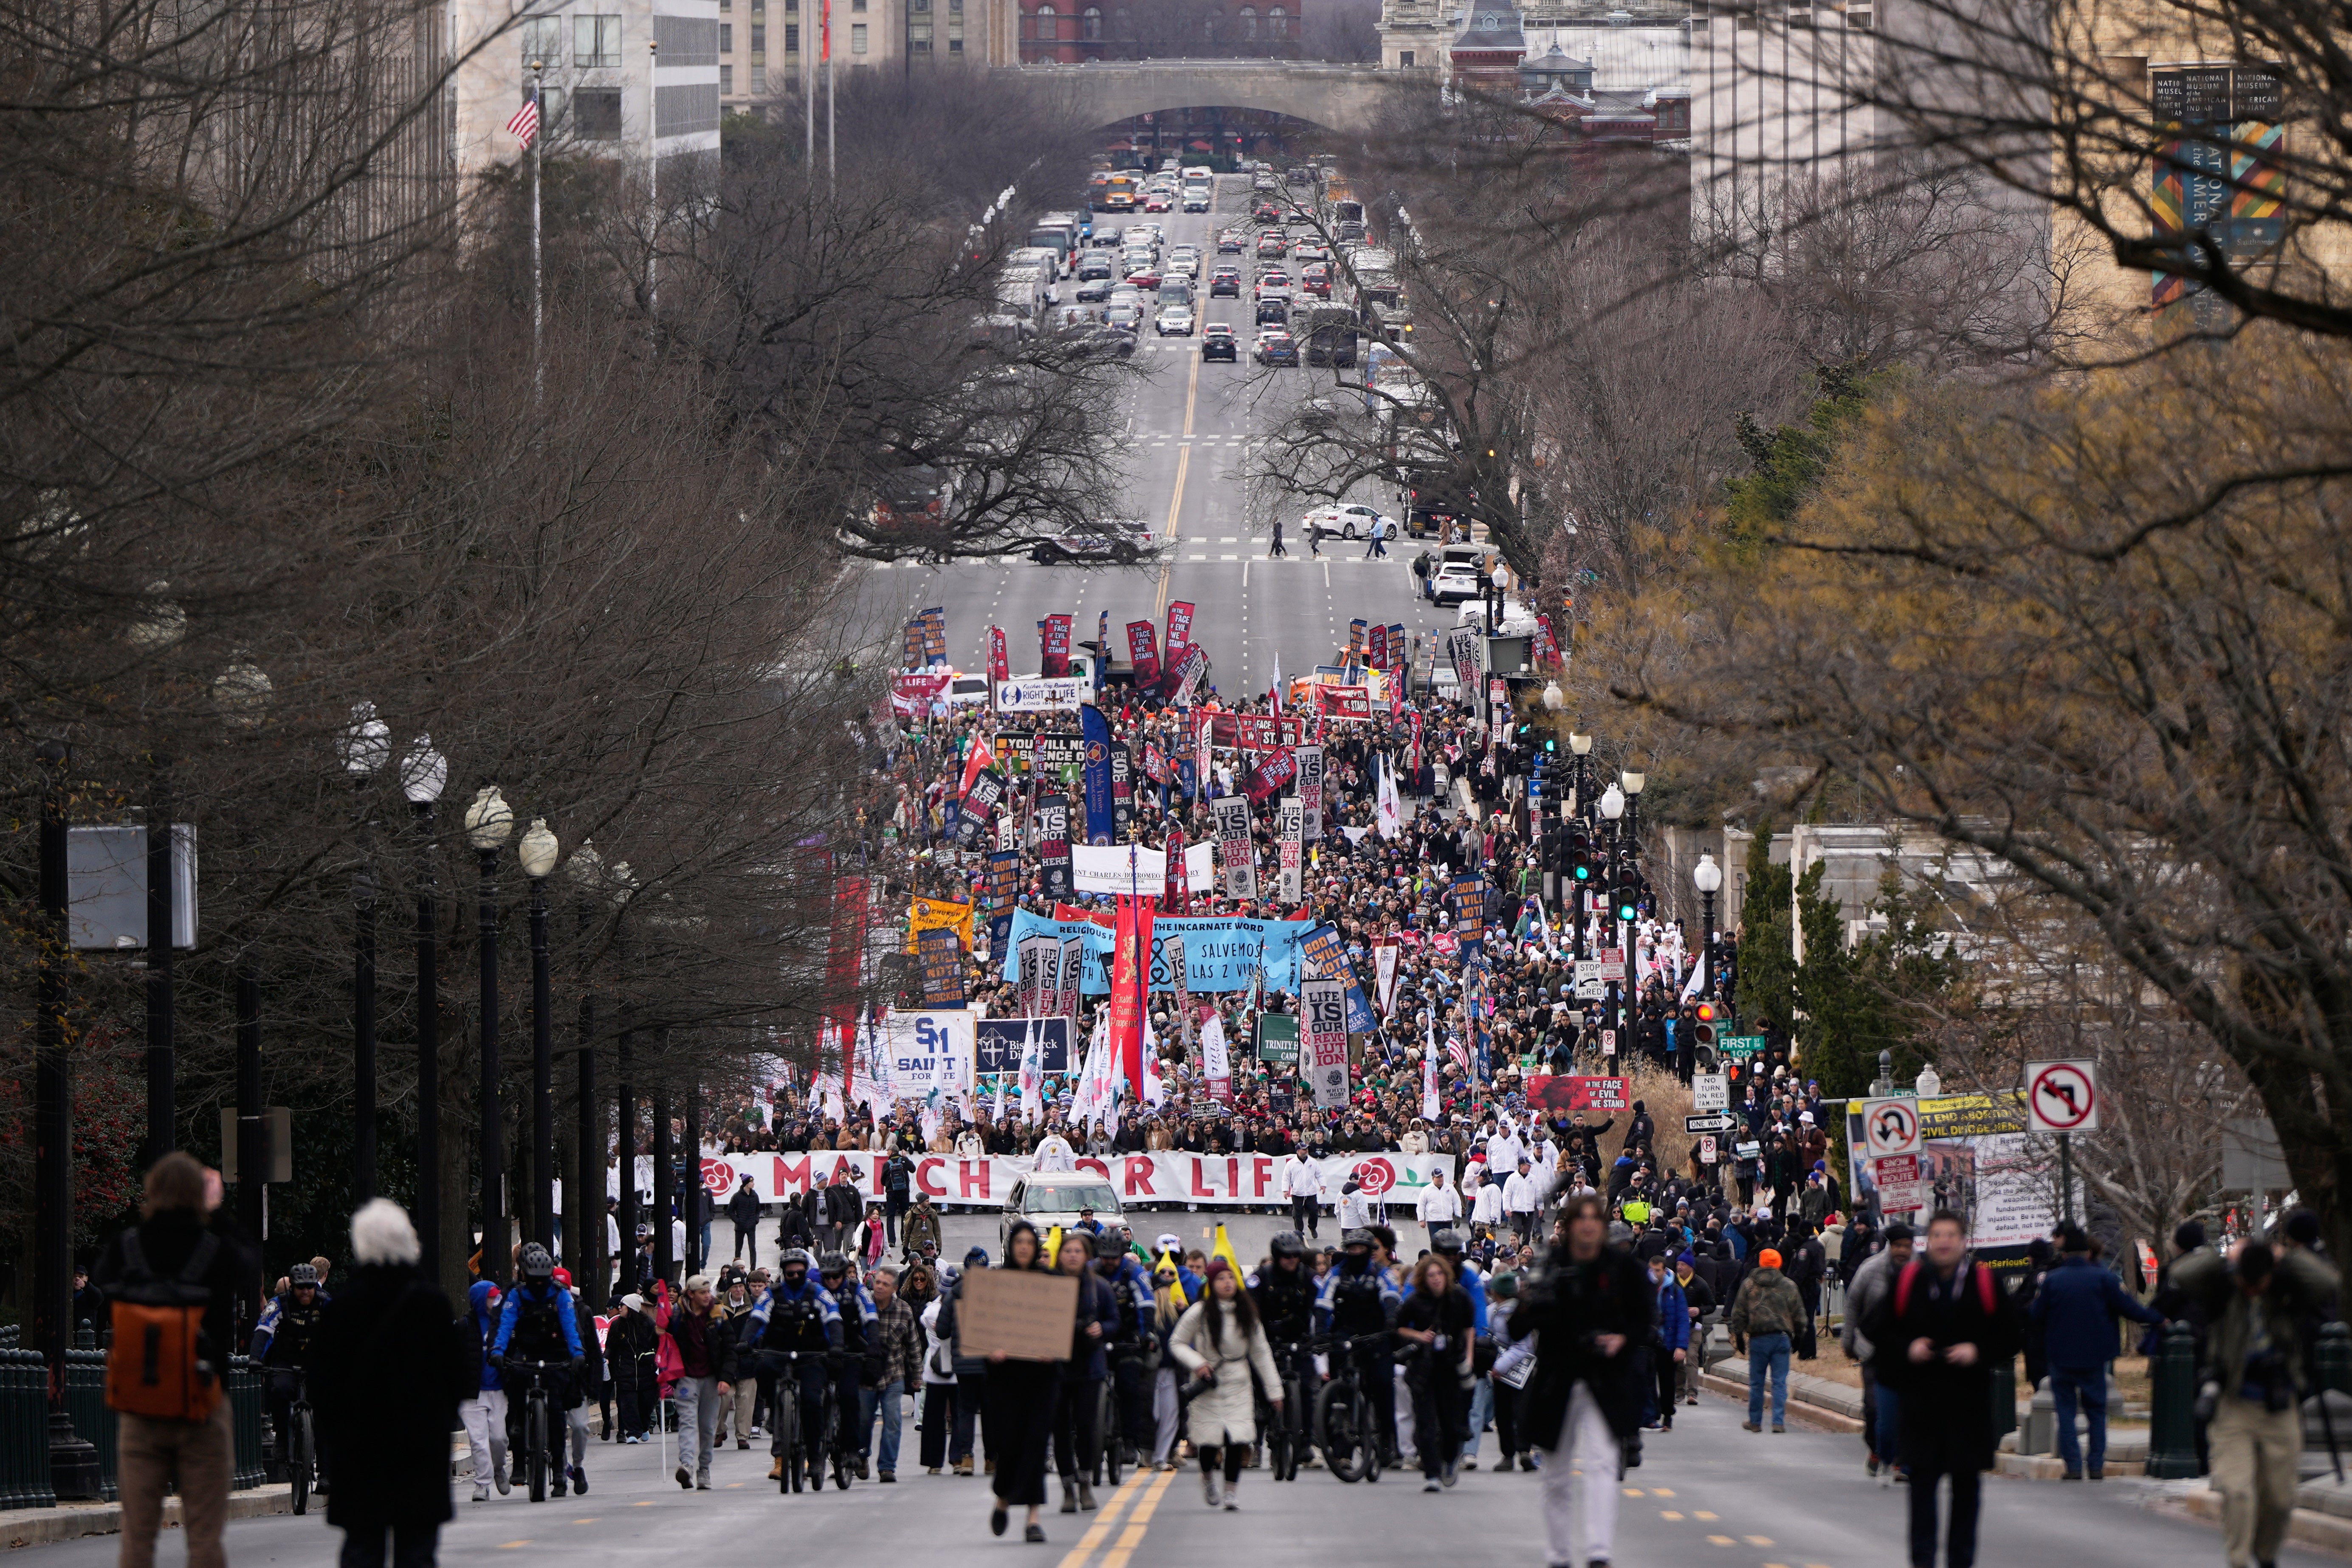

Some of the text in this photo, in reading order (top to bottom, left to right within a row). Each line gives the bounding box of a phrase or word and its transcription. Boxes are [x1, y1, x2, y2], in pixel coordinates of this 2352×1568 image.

[2193, 147, 2204, 166] the
[1175, 614, 1190, 623] FACE
[1176, 623, 1187, 632] EVIL,
[1136, 630, 1151, 638] FACE
[1171, 631, 1180, 639] WE
[1168, 639, 1185, 649] STAND
[1134, 651, 1153, 660] STAND
[1023, 689, 1075, 700] RIGHT LIFE
[1351, 700, 1368, 712] STAND
[1256, 719, 1272, 729] FACE
[1008, 739, 1084, 750] YOU NO
[1019, 750, 1074, 761] SIENCE
[1299, 754, 1320, 763] LIFE
[1267, 764, 1278, 776] WE
[1279, 758, 1292, 775] FACE
[1300, 763, 1320, 778] IS
[979, 773, 1001, 792] DEATH
[1261, 767, 1276, 787] STAND
[1300, 777, 1320, 786] OUR
[973, 778, 1000, 802] IS
[1300, 785, 1320, 793] REVO
[970, 790, 995, 807] NOT
[1041, 806, 1066, 815] DEATH
[1216, 805, 1244, 815] LIFE
[1282, 807, 1300, 815] LIFE
[961, 807, 986, 826] HERE!
[1041, 813, 1066, 832] IS
[1218, 814, 1247, 832] IS
[1281, 816, 1300, 832] IS
[1041, 830, 1066, 841] NOT
[1221, 830, 1248, 841] OUR
[999, 833, 1010, 852] IS
[1042, 840, 1068, 849] WEL
[1223, 839, 1249, 849] REVO
[1224, 847, 1250, 858] LUT
[993, 860, 1010, 872] GOD
[1042, 857, 1069, 866] HERE!
[1226, 857, 1252, 867] ION!
[999, 871, 1017, 883] WILL
[998, 883, 1012, 896] NOT
[1457, 881, 1475, 894] GOD
[1004, 894, 1014, 905] BE
[1463, 893, 1483, 905] WILL
[1461, 906, 1479, 919] NOT
[1175, 922, 1232, 931] INCARNATE
[1235, 922, 1264, 932] WORD
[1472, 918, 1482, 929] BE
[1060, 926, 1106, 941] RELIGIOUS
[1202, 943, 1261, 958] SALVEMOS
[1304, 936, 1328, 955] GOD
[1020, 947, 1037, 962] LIFE
[1314, 944, 1344, 962] WILL
[1021, 958, 1037, 981] IS
[1043, 959, 1056, 980] IS
[1193, 963, 1269, 979] LAS 2 VIDS
[926, 990, 962, 1003] MOCKED
[1114, 993, 1139, 1003] Traditio
[1308, 991, 1340, 1003] LIFE
[1116, 1006, 1138, 1016] Family
[1310, 1002, 1342, 1023] IS
[1110, 1017, 1139, 1028] Propert
[1311, 1022, 1344, 1034] OUR
[1313, 1032, 1345, 1044] REVO
[1720, 1038, 1752, 1048] FIRST
[1265, 1040, 1293, 1049] TRINITY
[1314, 1043, 1345, 1055] LUT
[1602, 1080, 1622, 1089] FACE
[1591, 1099, 1625, 1108] WE STAND
[1935, 1113, 1958, 1122] END
[1921, 1126, 1947, 1137] CIVIL
[1883, 1157, 1909, 1167] SNOW
[1878, 1165, 1915, 1175] EMERGENCY
[1191, 1157, 1273, 1198] LIF
[1882, 1171, 1914, 1183] ROUTE
[1977, 1257, 2029, 1269] GetSeriousC
